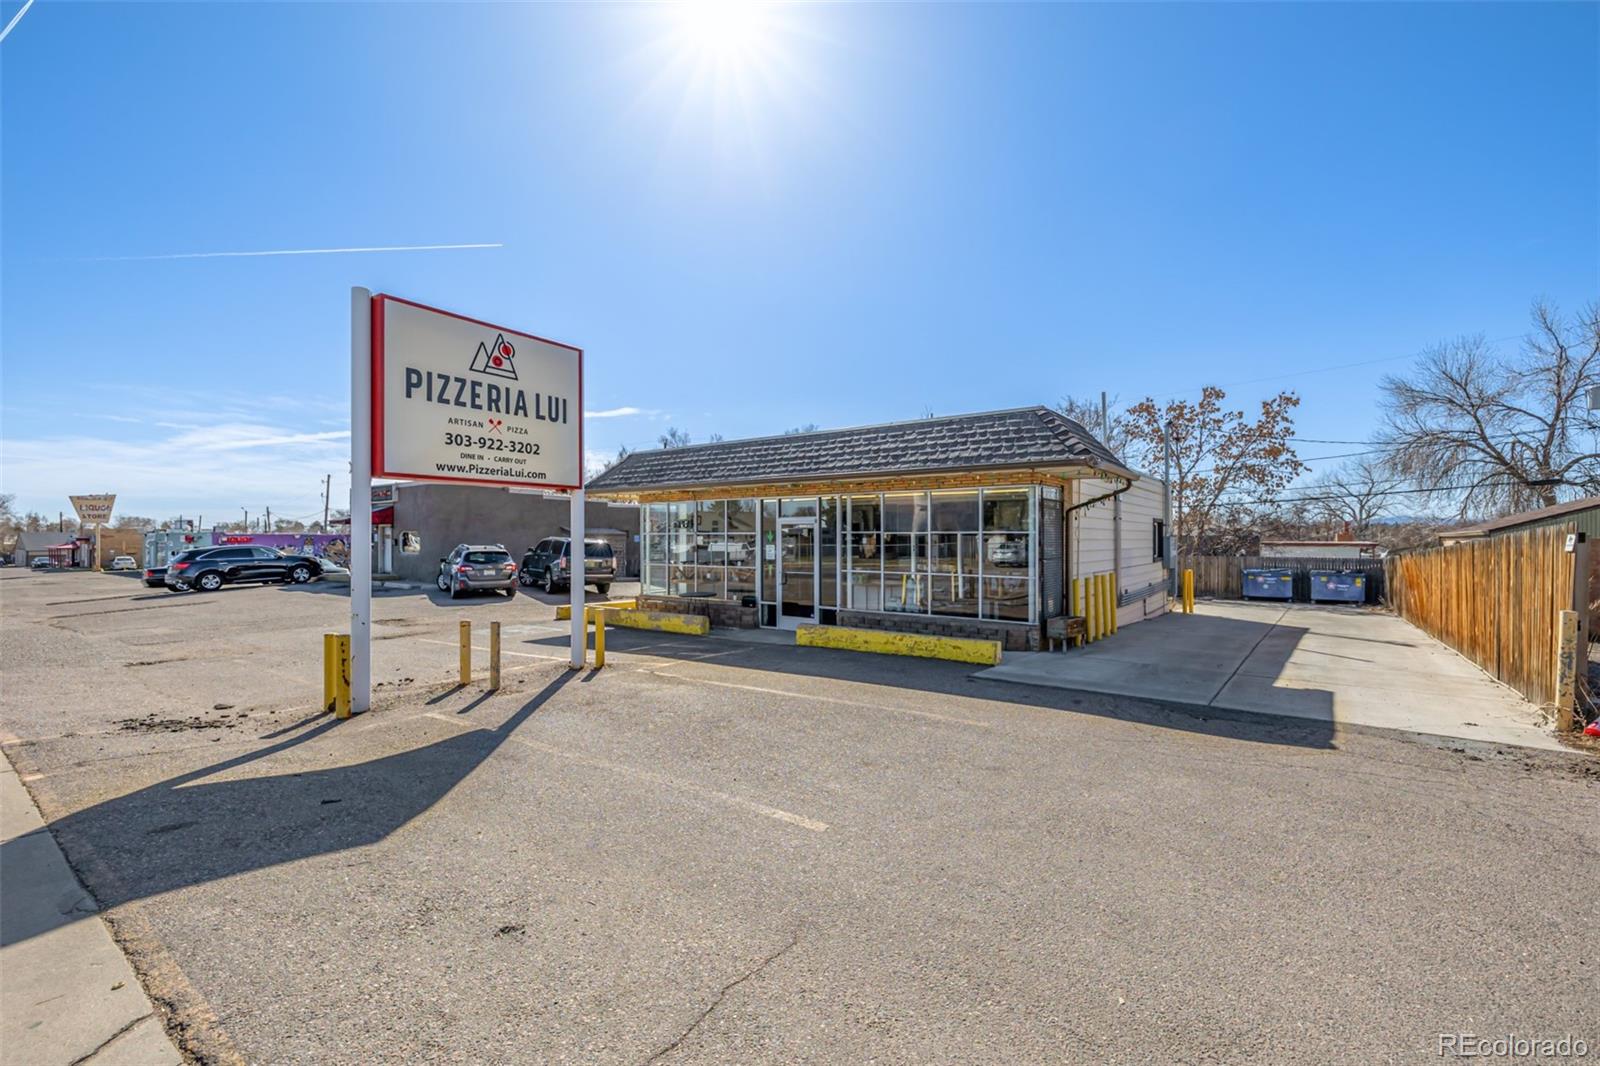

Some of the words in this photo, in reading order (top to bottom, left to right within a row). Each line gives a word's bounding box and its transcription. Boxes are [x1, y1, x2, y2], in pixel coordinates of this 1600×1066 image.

[405, 367, 529, 418] PIZZERIA
[535, 392, 567, 424] LUI
[447, 417, 484, 428] ARTISAN
[507, 425, 529, 435] PIZZA
[444, 432, 540, 455] 303-922-3202
[460, 452, 476, 460] DINE
[477, 453, 485, 461] IN
[494, 456, 514, 464] CARRY
[514, 457, 527, 465] OUT
[435, 462, 546, 480] www.PizzeriaLui.com
